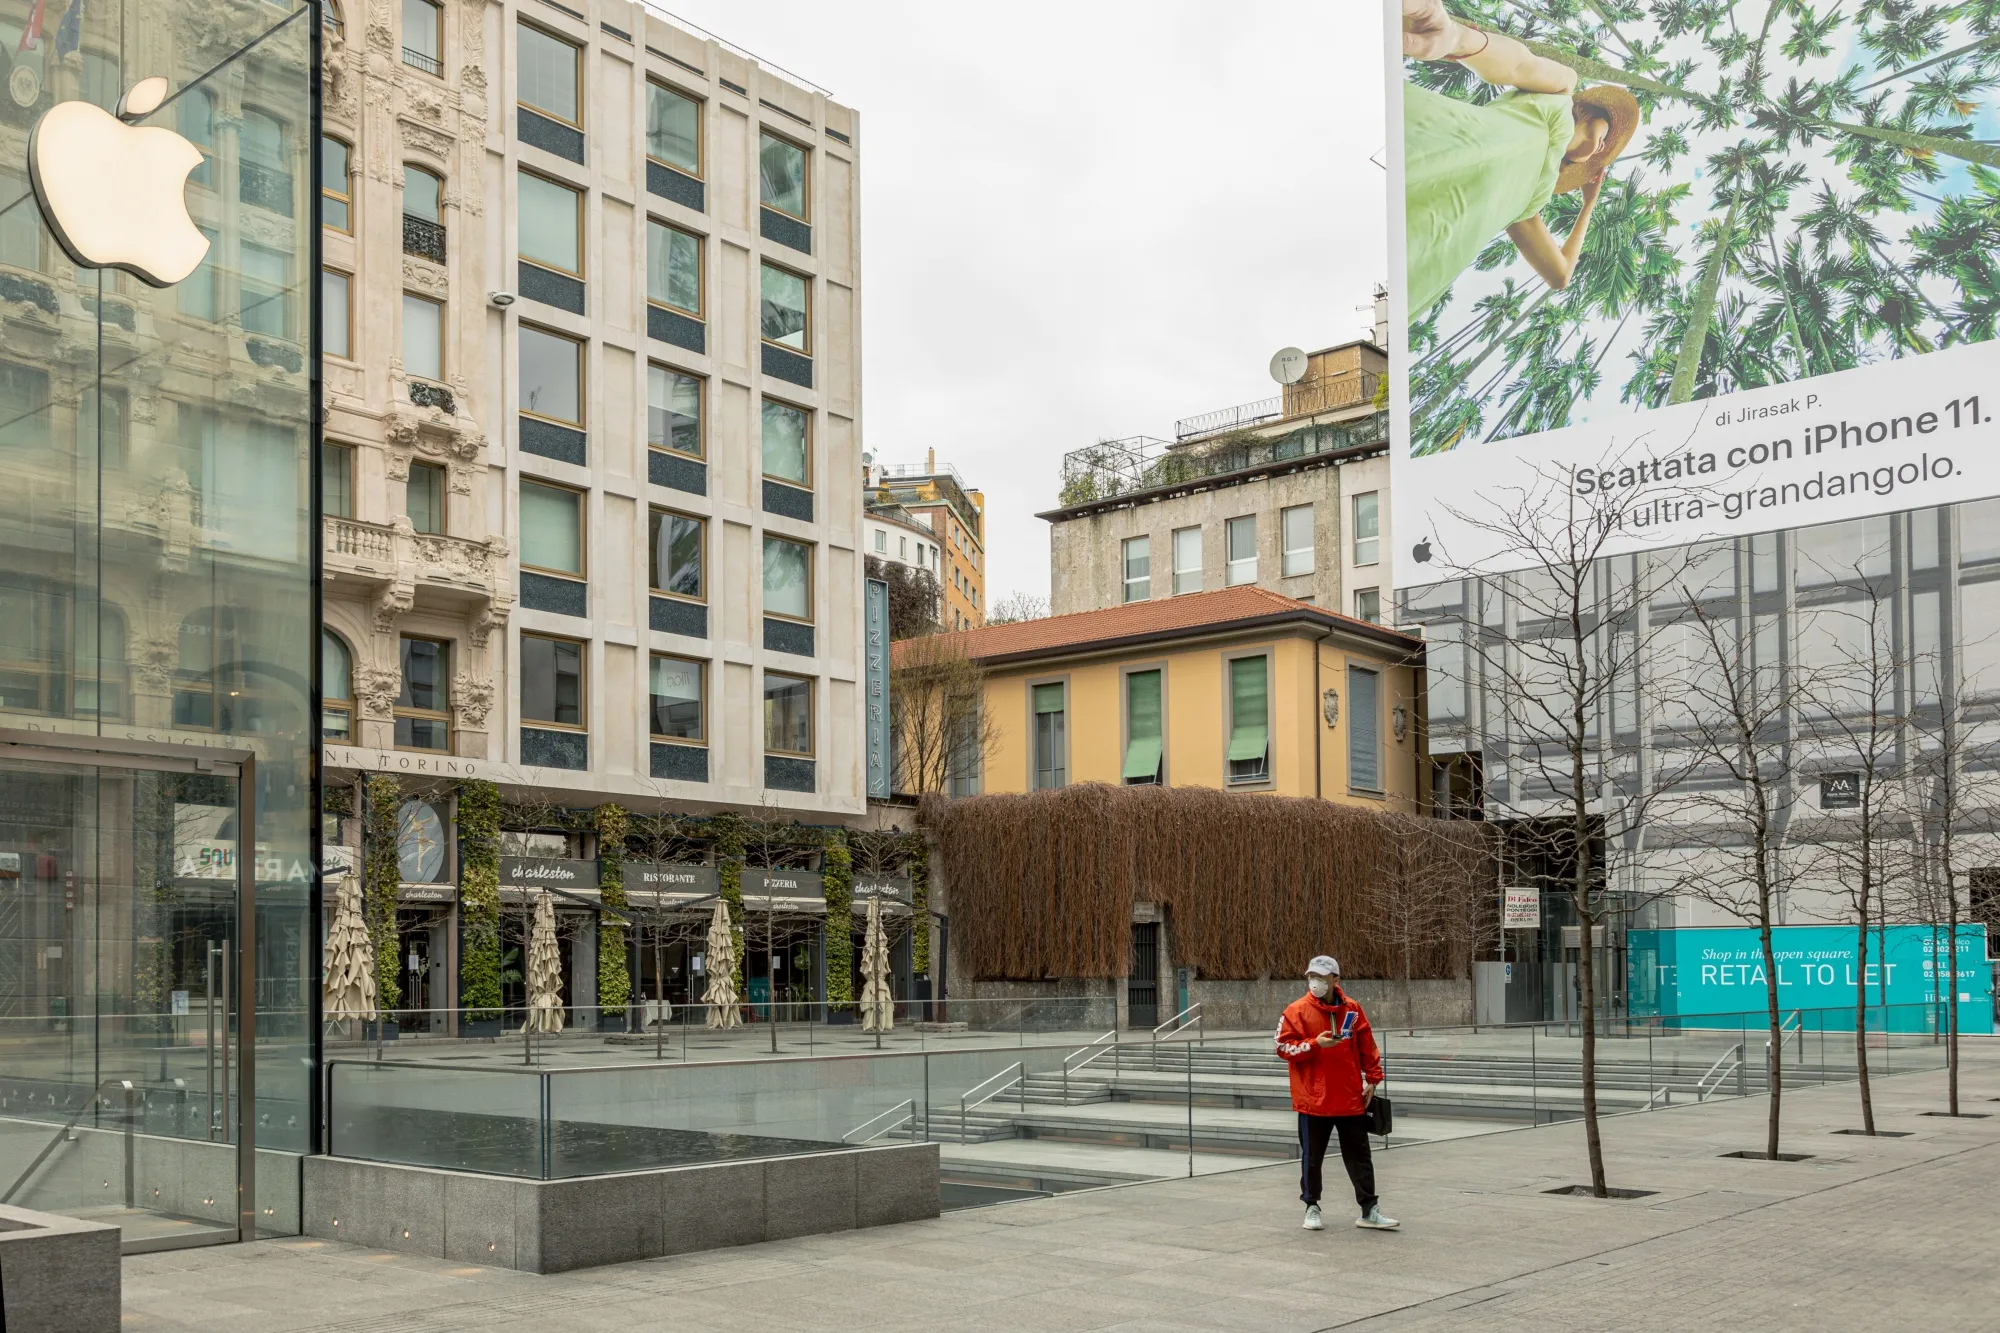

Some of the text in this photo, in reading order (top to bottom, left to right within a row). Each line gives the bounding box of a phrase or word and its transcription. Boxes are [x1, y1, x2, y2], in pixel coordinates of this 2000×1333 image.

[1715, 394, 1822, 427] di Jirasak P.
[1575, 395, 1992, 495] Scattata con iPhone 11.
[1633, 452, 1962, 529] ultra-grandangolo.
[869, 583, 883, 769] PIZZERIA
[380, 755, 476, 775] TORINO
[512, 865, 576, 880] charleston
[763, 878, 798, 889] PZZERIA
[854, 881, 900, 895] charlston
[405, 890, 443, 899] charleston
[1701, 948, 1853, 962] Shop in th open square.
[1702, 964, 1793, 986] RETAL
[1801, 964, 1834, 986] TO
[1846, 963, 1897, 986] LET
